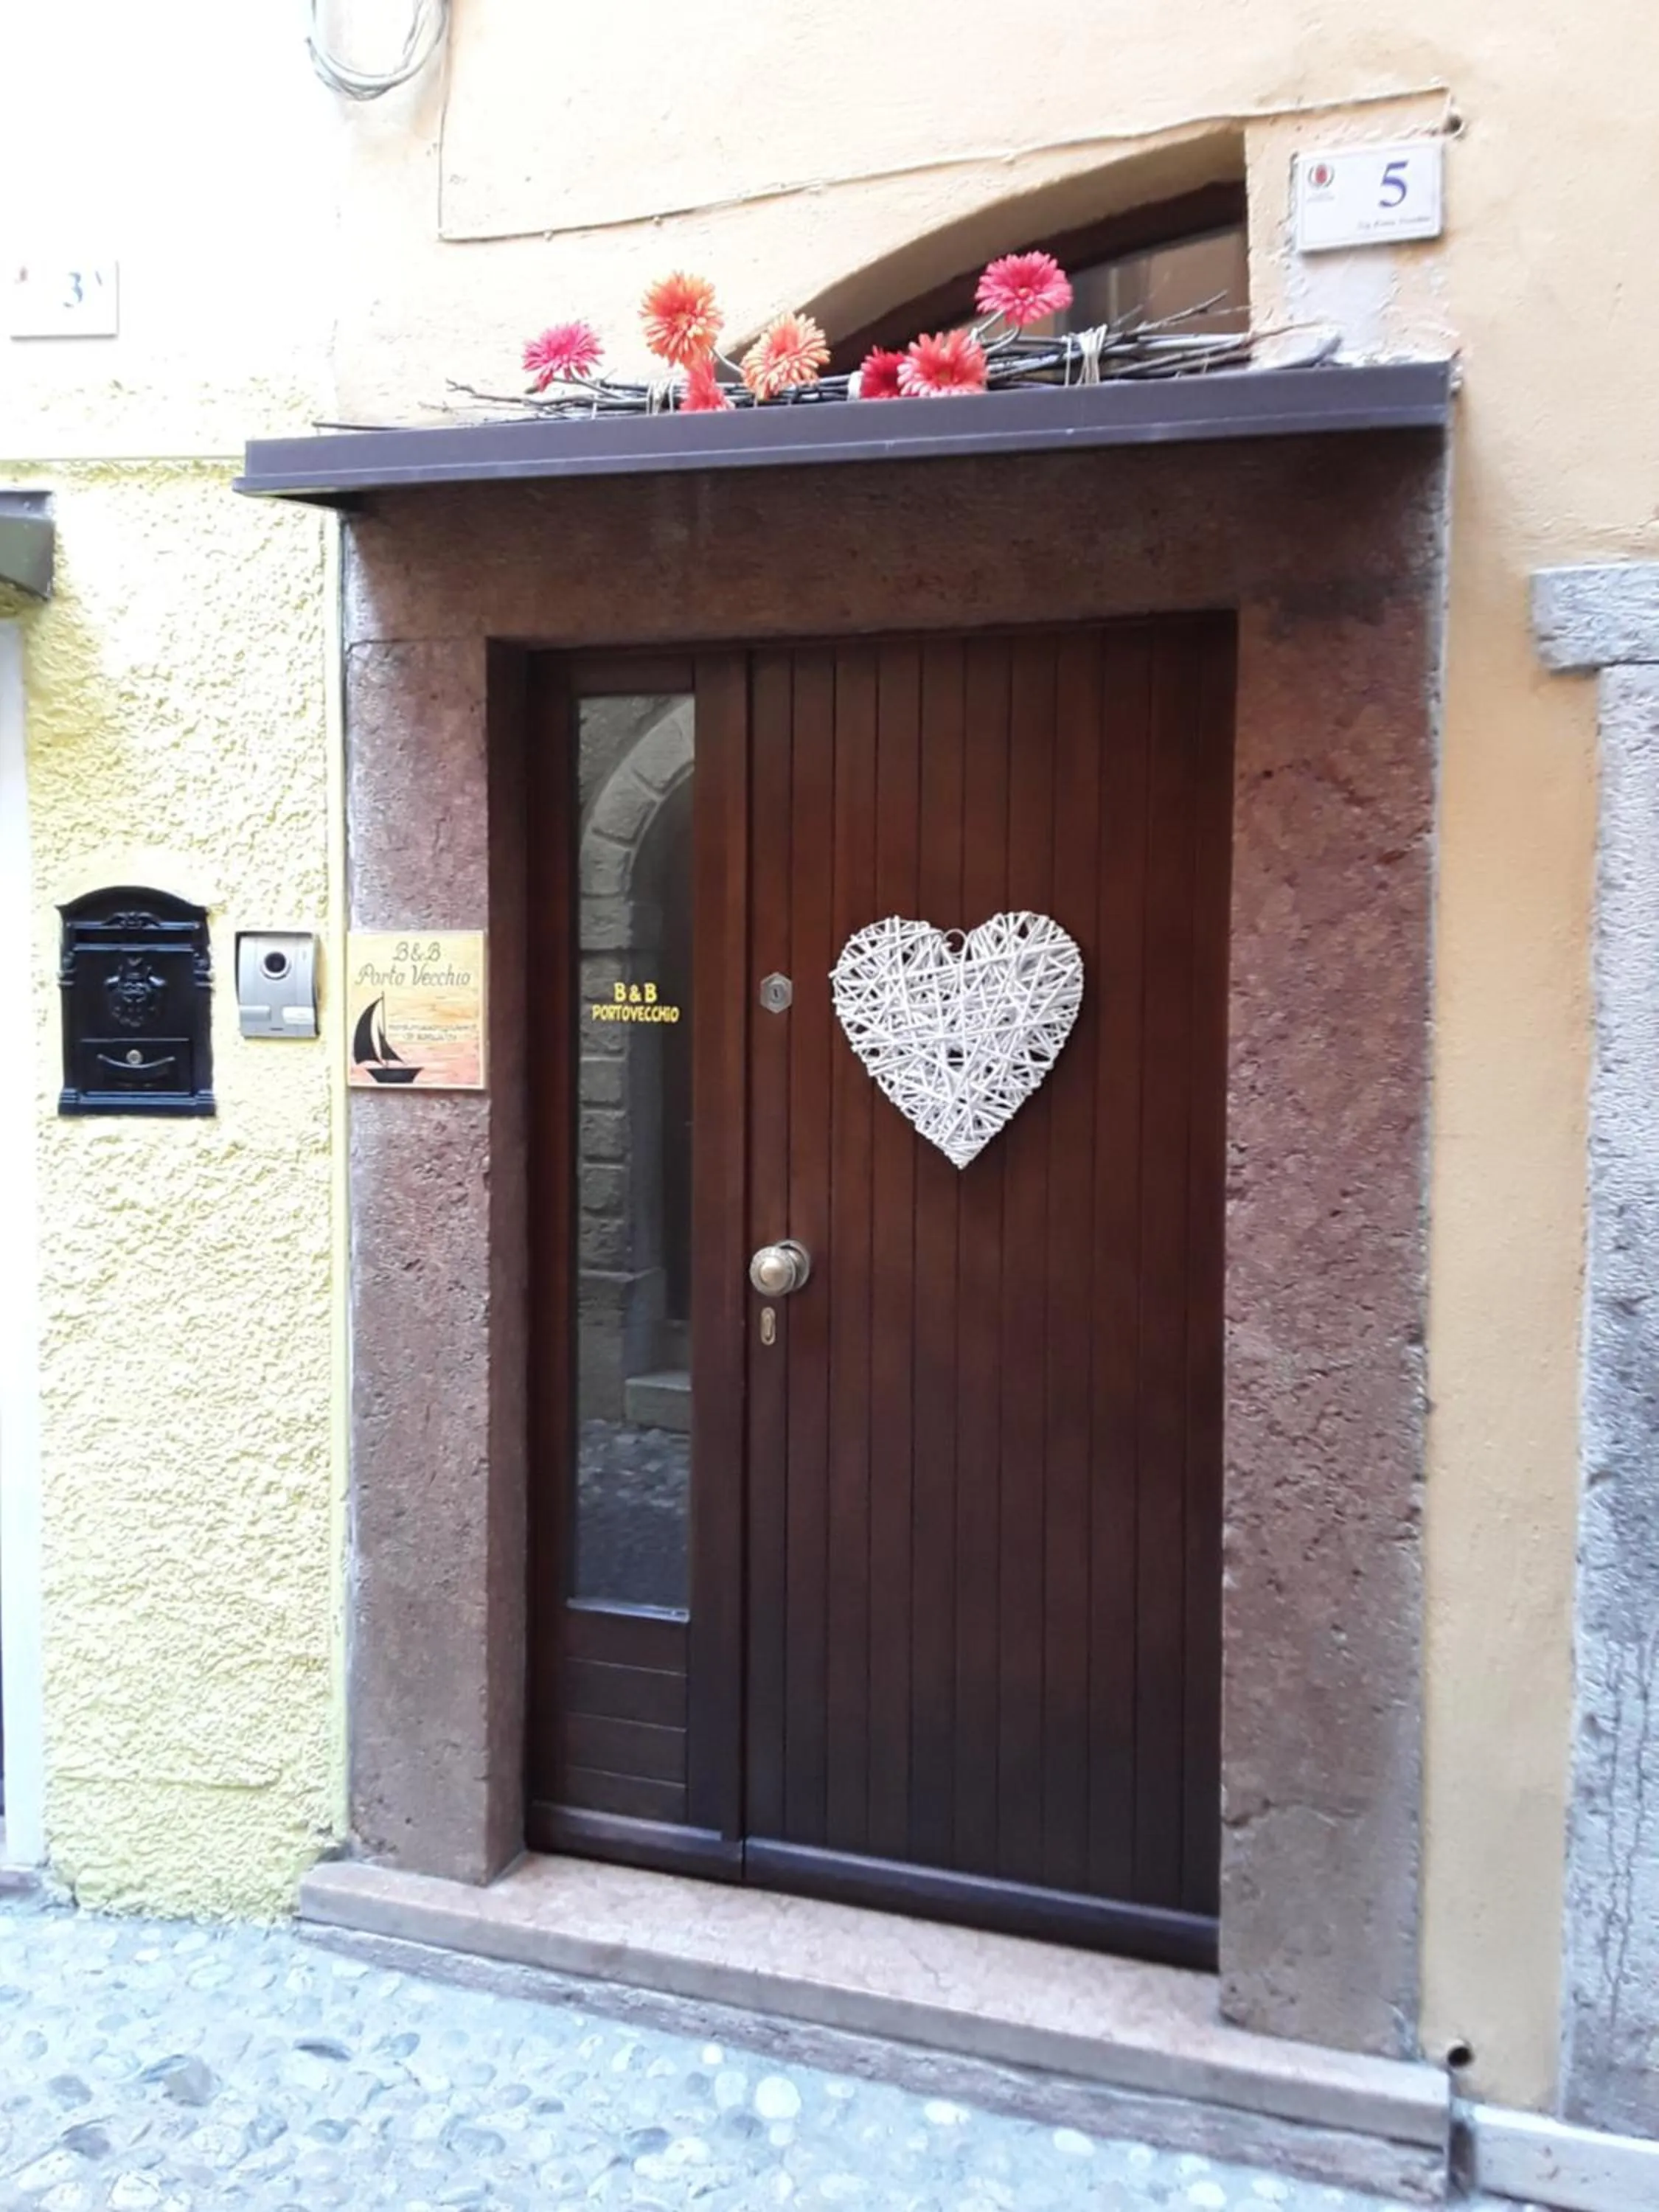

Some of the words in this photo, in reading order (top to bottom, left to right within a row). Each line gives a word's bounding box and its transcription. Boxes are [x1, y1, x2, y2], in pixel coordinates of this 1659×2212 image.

[1378, 159, 1409, 208] 5
[411, 962, 470, 987] Vecchio
[592, 1004, 680, 1023] PORTOVECCHIO
